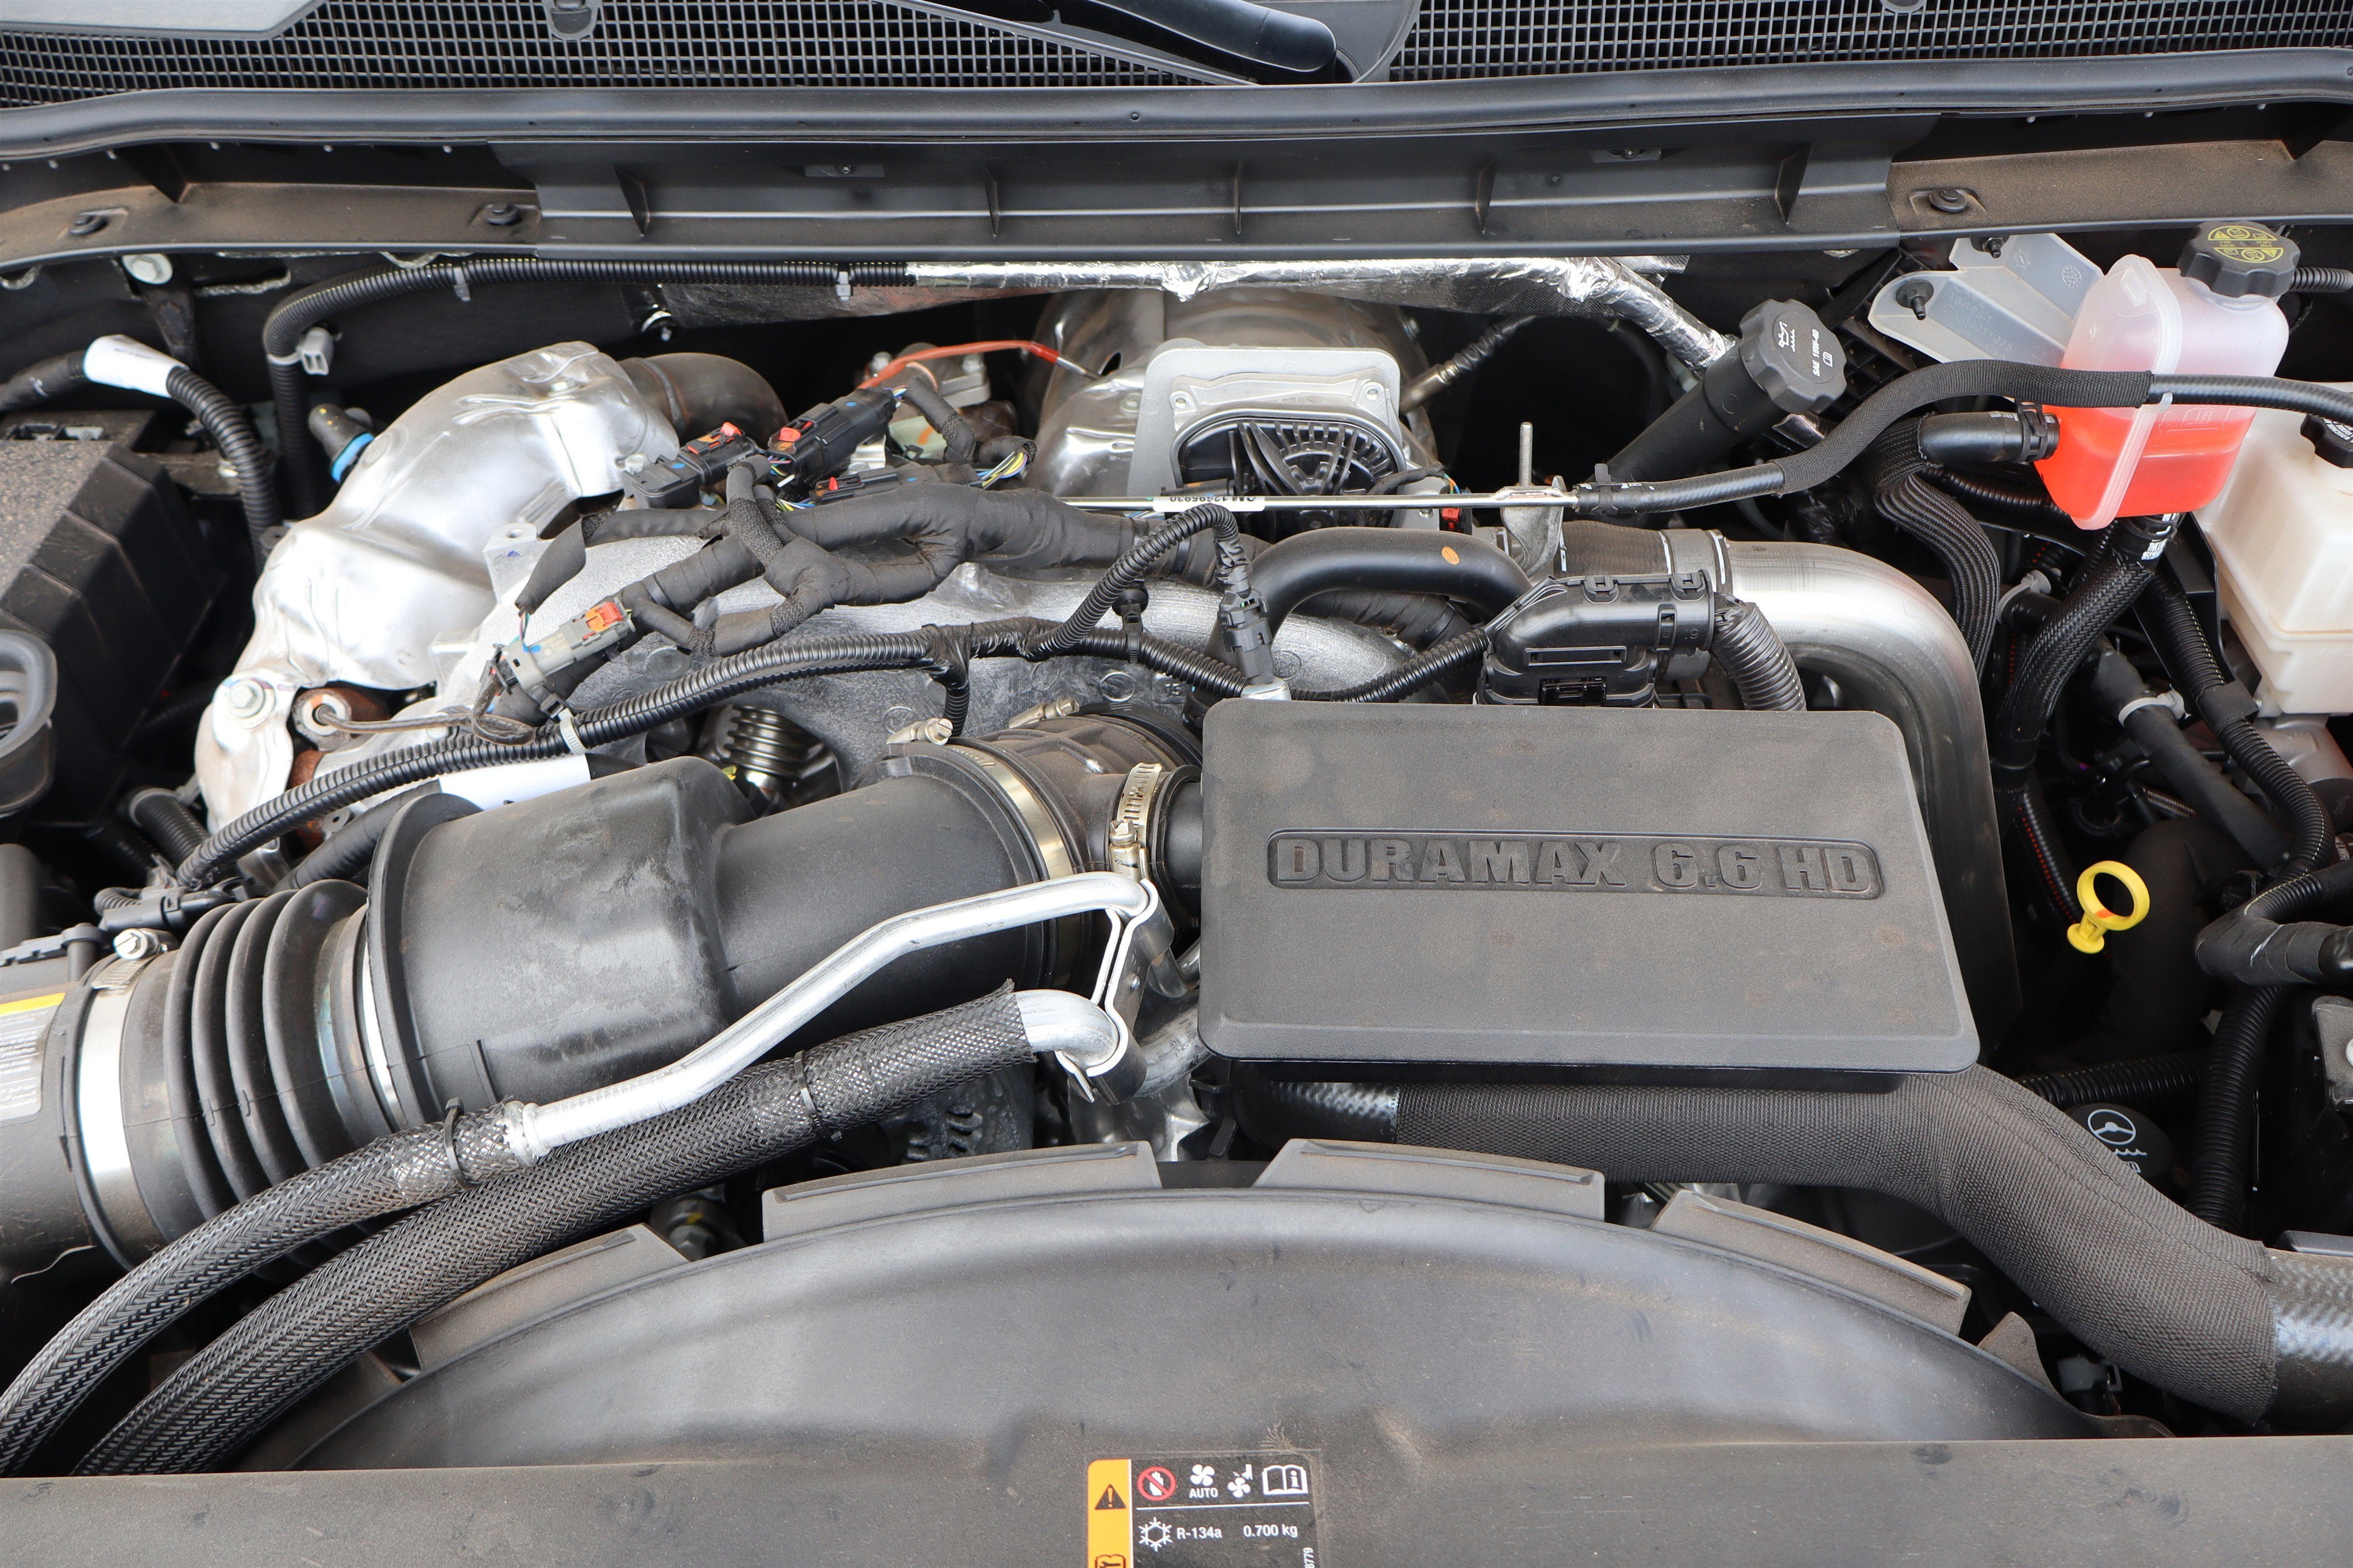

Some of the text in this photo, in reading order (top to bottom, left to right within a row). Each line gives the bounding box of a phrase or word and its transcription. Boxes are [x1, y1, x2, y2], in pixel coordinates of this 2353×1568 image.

[1812, 360, 1820, 377] SAE
[1276, 839, 1872, 893] DURAMAX 6.6 HD
[1189, 1487, 1218, 1499] AUTO
[1176, 1524, 1298, 1539] R-134a 0.700 kg
